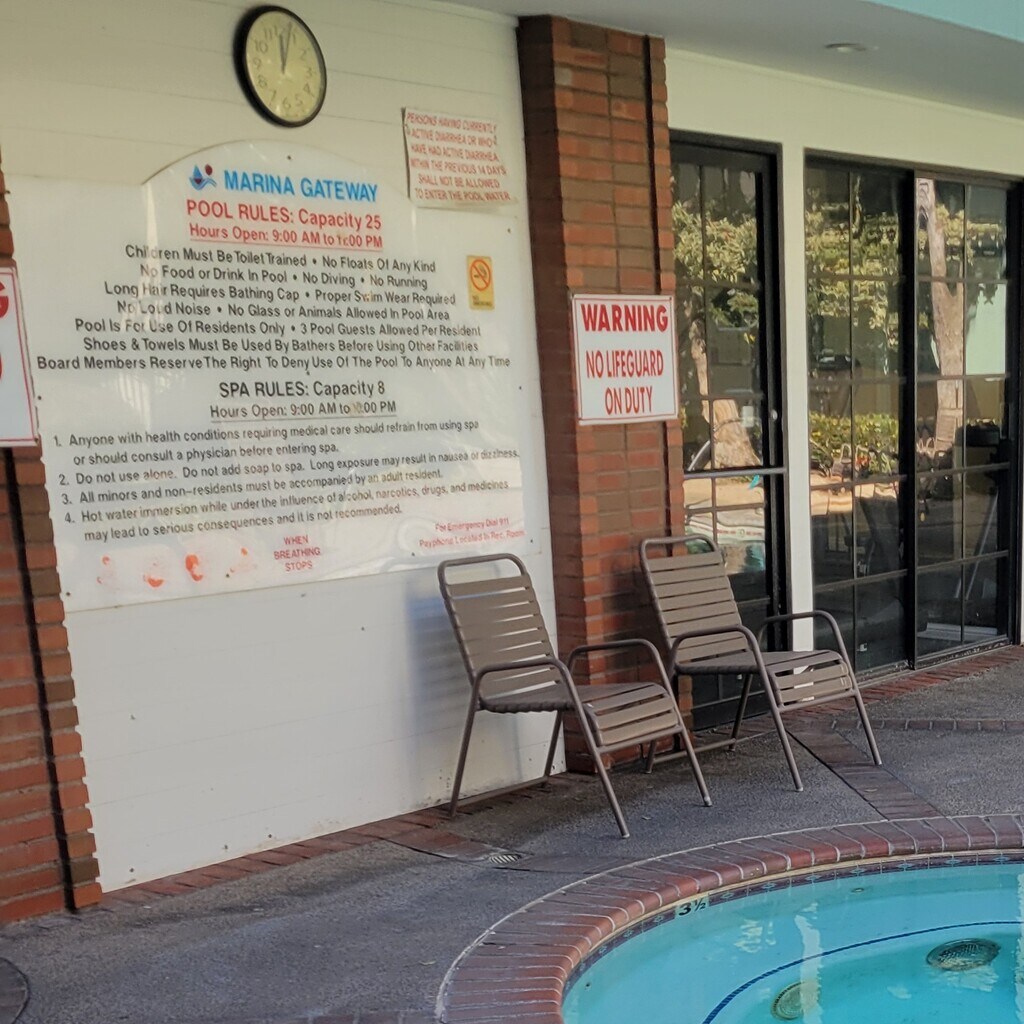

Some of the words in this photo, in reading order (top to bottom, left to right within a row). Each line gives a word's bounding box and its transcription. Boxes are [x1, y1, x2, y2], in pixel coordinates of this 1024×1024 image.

[255, 39, 269, 54] 10
[224, 170, 295, 195] MARINA
[300, 178, 378, 202] GATEWAY
[186, 199, 233, 219] POOL
[238, 204, 294, 224] RULES:
[298, 208, 362, 232] Capacity
[366, 214, 382, 230] 25
[189, 223, 228, 238] Hours
[232, 226, 268, 242] Open:
[272, 230, 297, 243] 9:00
[302, 231, 320, 245] AM
[323, 233, 335, 246] to
[366, 235, 383, 248] PM
[184, 248, 213, 261] Must
[217, 250, 232, 263] Be
[235, 250, 264, 265] Toilet
[265, 252, 307, 266] Trained
[323, 255, 337, 268] No
[341, 256, 374, 270] Floats
[378, 257, 389, 270] Of
[392, 259, 411, 274] Any
[413, 261, 436, 272] Kind
[140, 264, 158, 277] No
[162, 265, 194, 279] Food
[198, 269, 210, 280] or
[213, 268, 244, 281] Drink
[248, 270, 258, 281] In
[262, 270, 287, 282] Pool
[303, 271, 318, 283] No
[322, 274, 355, 288] Diving
[370, 275, 384, 287] No
[387, 276, 427, 291] Running
[104, 281, 138, 299] Long
[143, 283, 167, 296] Hair
[170, 284, 225, 301] Requires
[229, 286, 273, 302] Bathing
[277, 288, 299, 301] Cap
[315, 289, 351, 304] Proper
[354, 290, 382, 302] Swim
[385, 292, 410, 303] Wear
[413, 293, 456, 306] Required
[117, 300, 133, 313] No
[176, 302, 210, 315] Noise
[228, 304, 244, 315] No
[248, 304, 280, 317] Glass
[284, 308, 295, 317] or
[299, 306, 342, 318] Animals
[346, 308, 387, 319] Allowed
[390, 308, 399, 319] In
[402, 309, 423, 320] Pool
[427, 310, 449, 320] Area
[581, 304, 668, 332] WARNING
[75, 318, 106, 331] Pool
[110, 319, 120, 331] Is
[125, 320, 145, 332] For
[150, 320, 173, 333] Use
[178, 320, 192, 333] Of
[196, 321, 256, 334] Residents
[260, 322, 285, 337] Only
[301, 323, 307, 334] 3
[310, 323, 334, 335] Pool
[338, 324, 375, 335] Guests
[379, 324, 419, 336] Allowed
[422, 325, 437, 336] Per
[440, 325, 481, 336] Resident
[83, 337, 126, 351] Shoes
[131, 338, 139, 350] &
[142, 337, 185, 351] Towels
[189, 338, 218, 350] Must
[222, 339, 238, 350] Be
[241, 339, 271, 351] Used
[275, 340, 289, 353] By
[292, 340, 335, 351] Bathers
[339, 340, 373, 351] Before
[376, 340, 405, 354] Using
[408, 340, 435, 351] Other
[438, 341, 478, 351] Facilities
[37, 356, 80, 369] Board
[84, 356, 146, 369] Members
[150, 356, 202, 369] Reserve
[204, 356, 226, 368] The
[231, 357, 261, 371] Right
[266, 356, 278, 368] To
[282, 356, 309, 371] Deny
[312, 356, 333, 368] Use
[337, 356, 349, 368] Of
[353, 357, 372, 367] The
[375, 357, 397, 367] Pool
[402, 356, 412, 367] To
[416, 356, 451, 369] Anyone
[456, 356, 465, 367] At
[468, 356, 486, 369] Any
[489, 356, 510, 367] Time
[586, 350, 604, 378] NO
[606, 350, 664, 378] LIFEGUARD
[219, 382, 250, 398] SPA
[255, 382, 309, 397] RULES:
[313, 380, 374, 399] Capacity
[378, 381, 385, 394] 8
[605, 387, 622, 415] ON
[625, 386, 652, 414] DUTY
[210, 405, 248, 418] Hours
[252, 405, 286, 420] Open:
[290, 404, 314, 415] 9:00
[319, 403, 336, 414] AM
[340, 403, 350, 414] to
[381, 401, 396, 413] PM
[69, 434, 114, 448] Anyone
[118, 432, 142, 444] with
[145, 430, 180, 443] health
[184, 428, 240, 441] conditions
[243, 426, 287, 440] requiring
[290, 425, 328, 437] medical
[331, 426, 351, 435] care
[354, 423, 384, 434] should
[387, 421, 415, 433] refrain
[417, 421, 437, 431] from
[440, 420, 462, 432] using
[464, 420, 479, 431] spa
[73, 455, 85, 465] or
[89, 452, 128, 464] should
[131, 451, 173, 462] consult
[177, 451, 183, 460] a
[186, 446, 237, 462] physician
[239, 445, 272, 457] before
[276, 444, 316, 457] entering
[319, 443, 339, 454] spa.
[80, 492, 94, 503] All
[98, 490, 137, 501] minors
[141, 487, 161, 499] and
[246, 480, 271, 491] must
[274, 478, 285, 489] be
[290, 475, 352, 488] accompanied
[355, 474, 365, 485] by
[368, 473, 378, 483] an
[382, 470, 402, 481] adult
[405, 469, 443, 480] resident.
[284, 535, 309, 545] WHEN
[274, 547, 320, 559] BREATHING
[285, 561, 313, 571] STOPS
